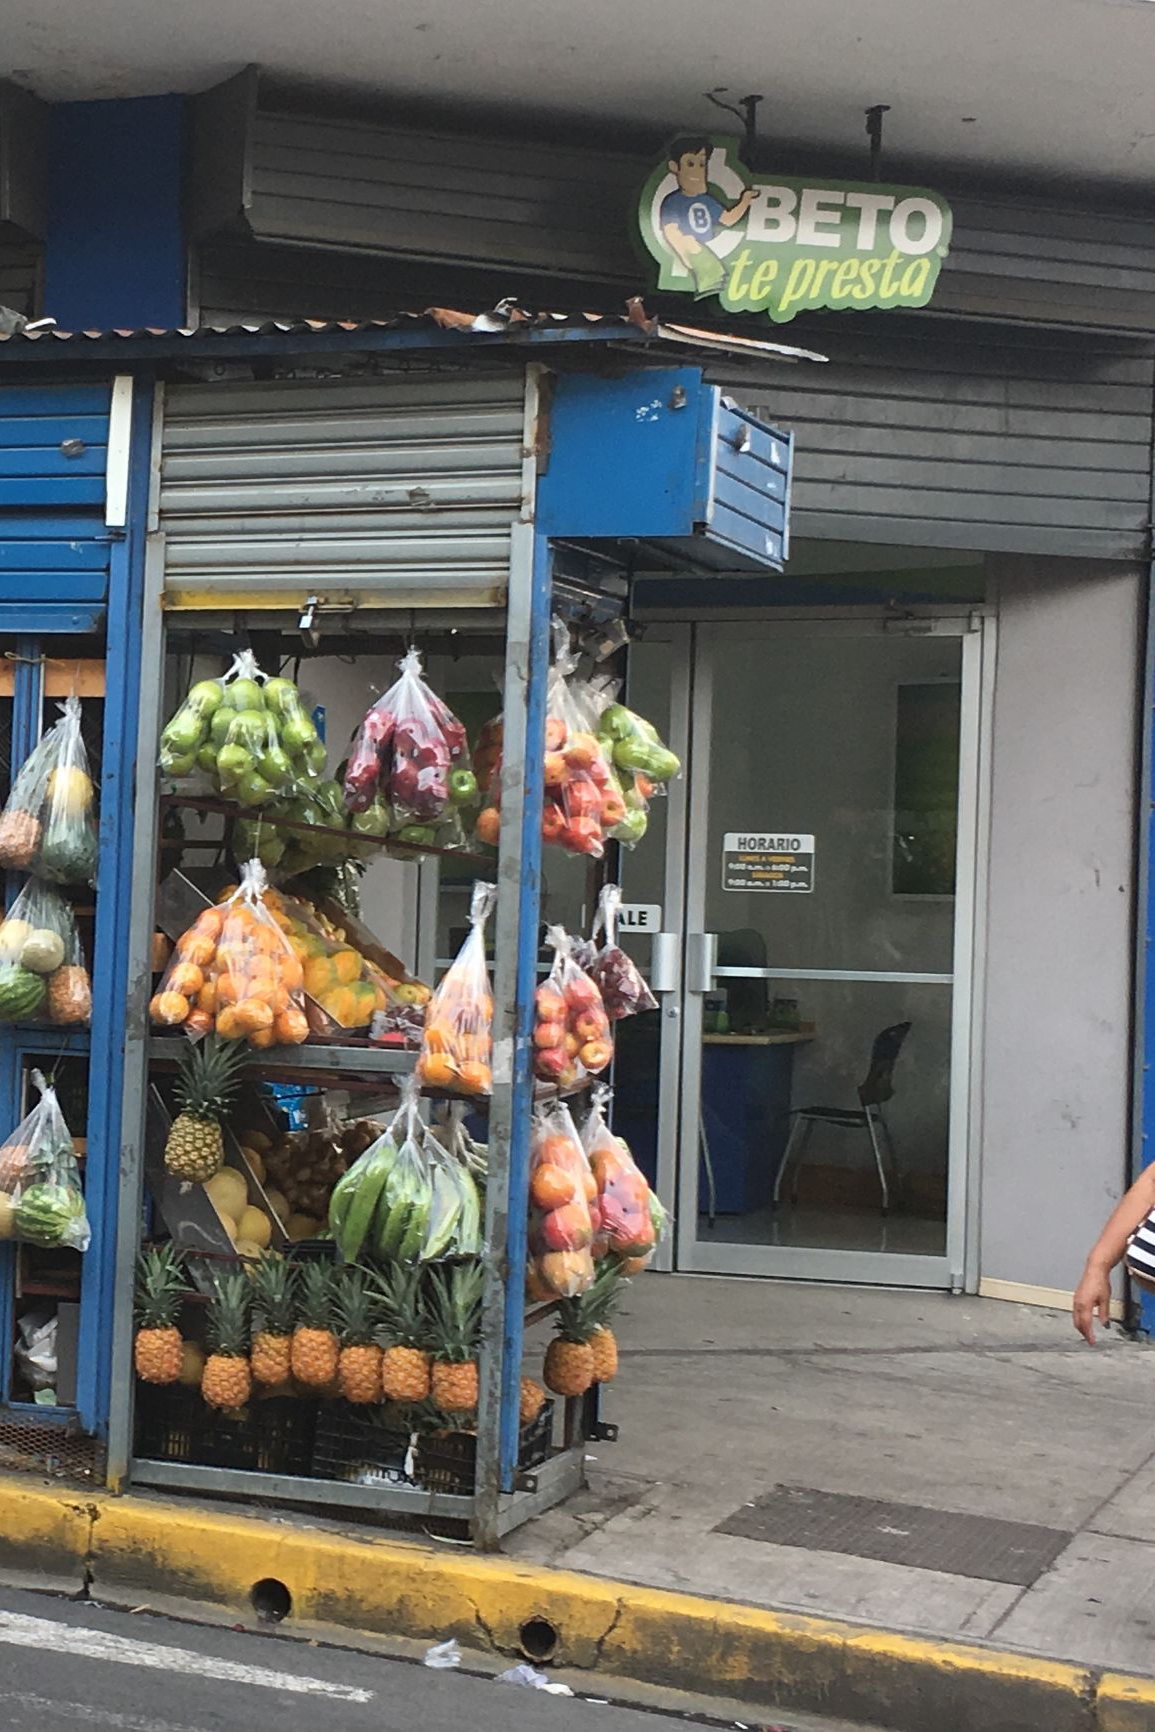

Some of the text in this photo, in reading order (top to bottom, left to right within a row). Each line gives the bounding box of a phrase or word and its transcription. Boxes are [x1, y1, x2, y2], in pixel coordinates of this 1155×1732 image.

[745, 184, 943, 256] BETO
[727, 249, 932, 312] te presta
[737, 837, 802, 851] HORARIO
[618, 911, 648, 926] ALE
